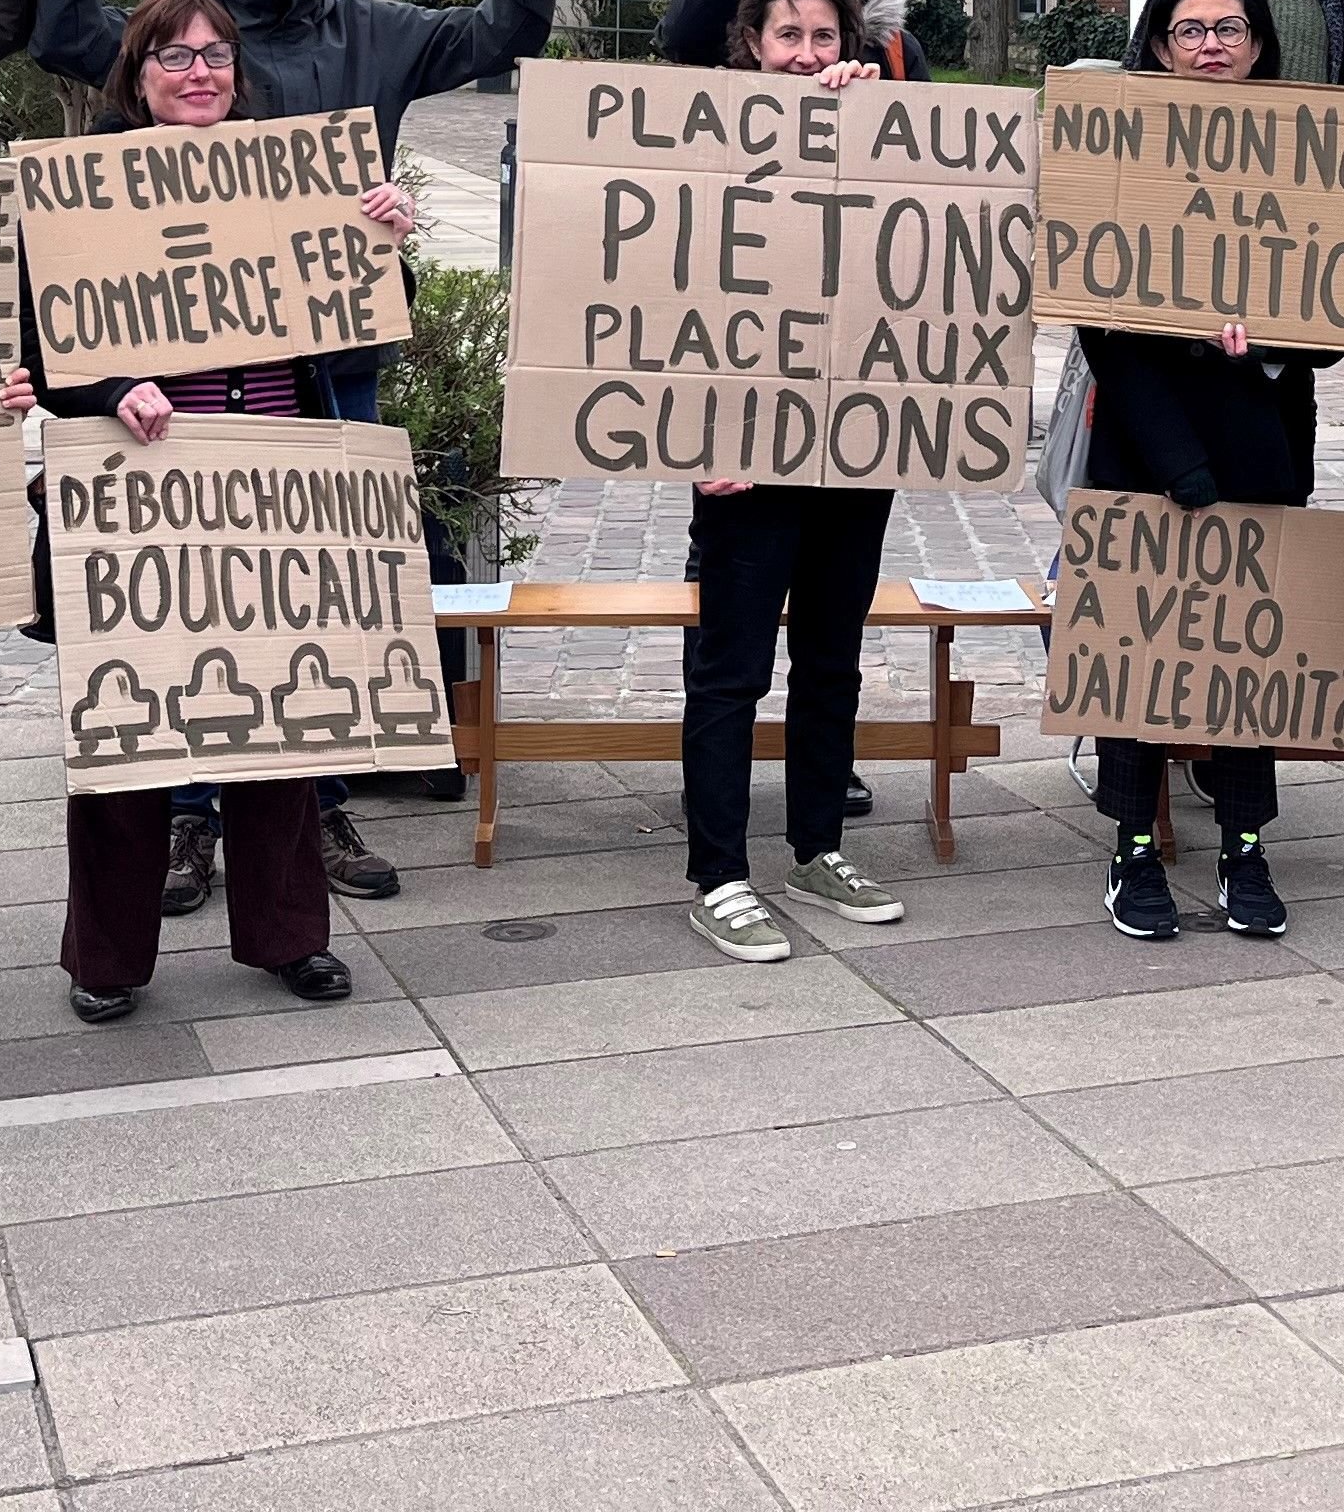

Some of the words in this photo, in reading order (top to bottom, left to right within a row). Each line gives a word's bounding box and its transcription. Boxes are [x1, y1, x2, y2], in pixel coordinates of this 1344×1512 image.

[19, 150, 113, 212] RUE
[121, 109, 383, 209] ENCOMBRÉE
[587, 83, 839, 163] PLACE
[871, 100, 1026, 175] AUX
[1054, 103, 1143, 162] NON
[1165, 101, 1276, 177] NON
[603, 158, 1035, 318] PIÉTONS
[1183, 172, 1215, 220] À
[1233, 190, 1288, 233] LA
[39, 254, 288, 355] COMMERCE
[585, 303, 829, 380] PLACE
[858, 316, 1011, 389] AUX
[574, 380, 1013, 482] GUIDONS
[60, 450, 422, 544] DÉBOUCHONNONS
[85, 543, 407, 635] BOUCICAUT
[1065, 495, 1270, 594] SÉNIOR
[1068, 568, 1105, 629] À
[1137, 581, 1284, 658] VÉLO
[1048, 636, 1130, 722] J'AI
[1145, 659, 1194, 729] LE
